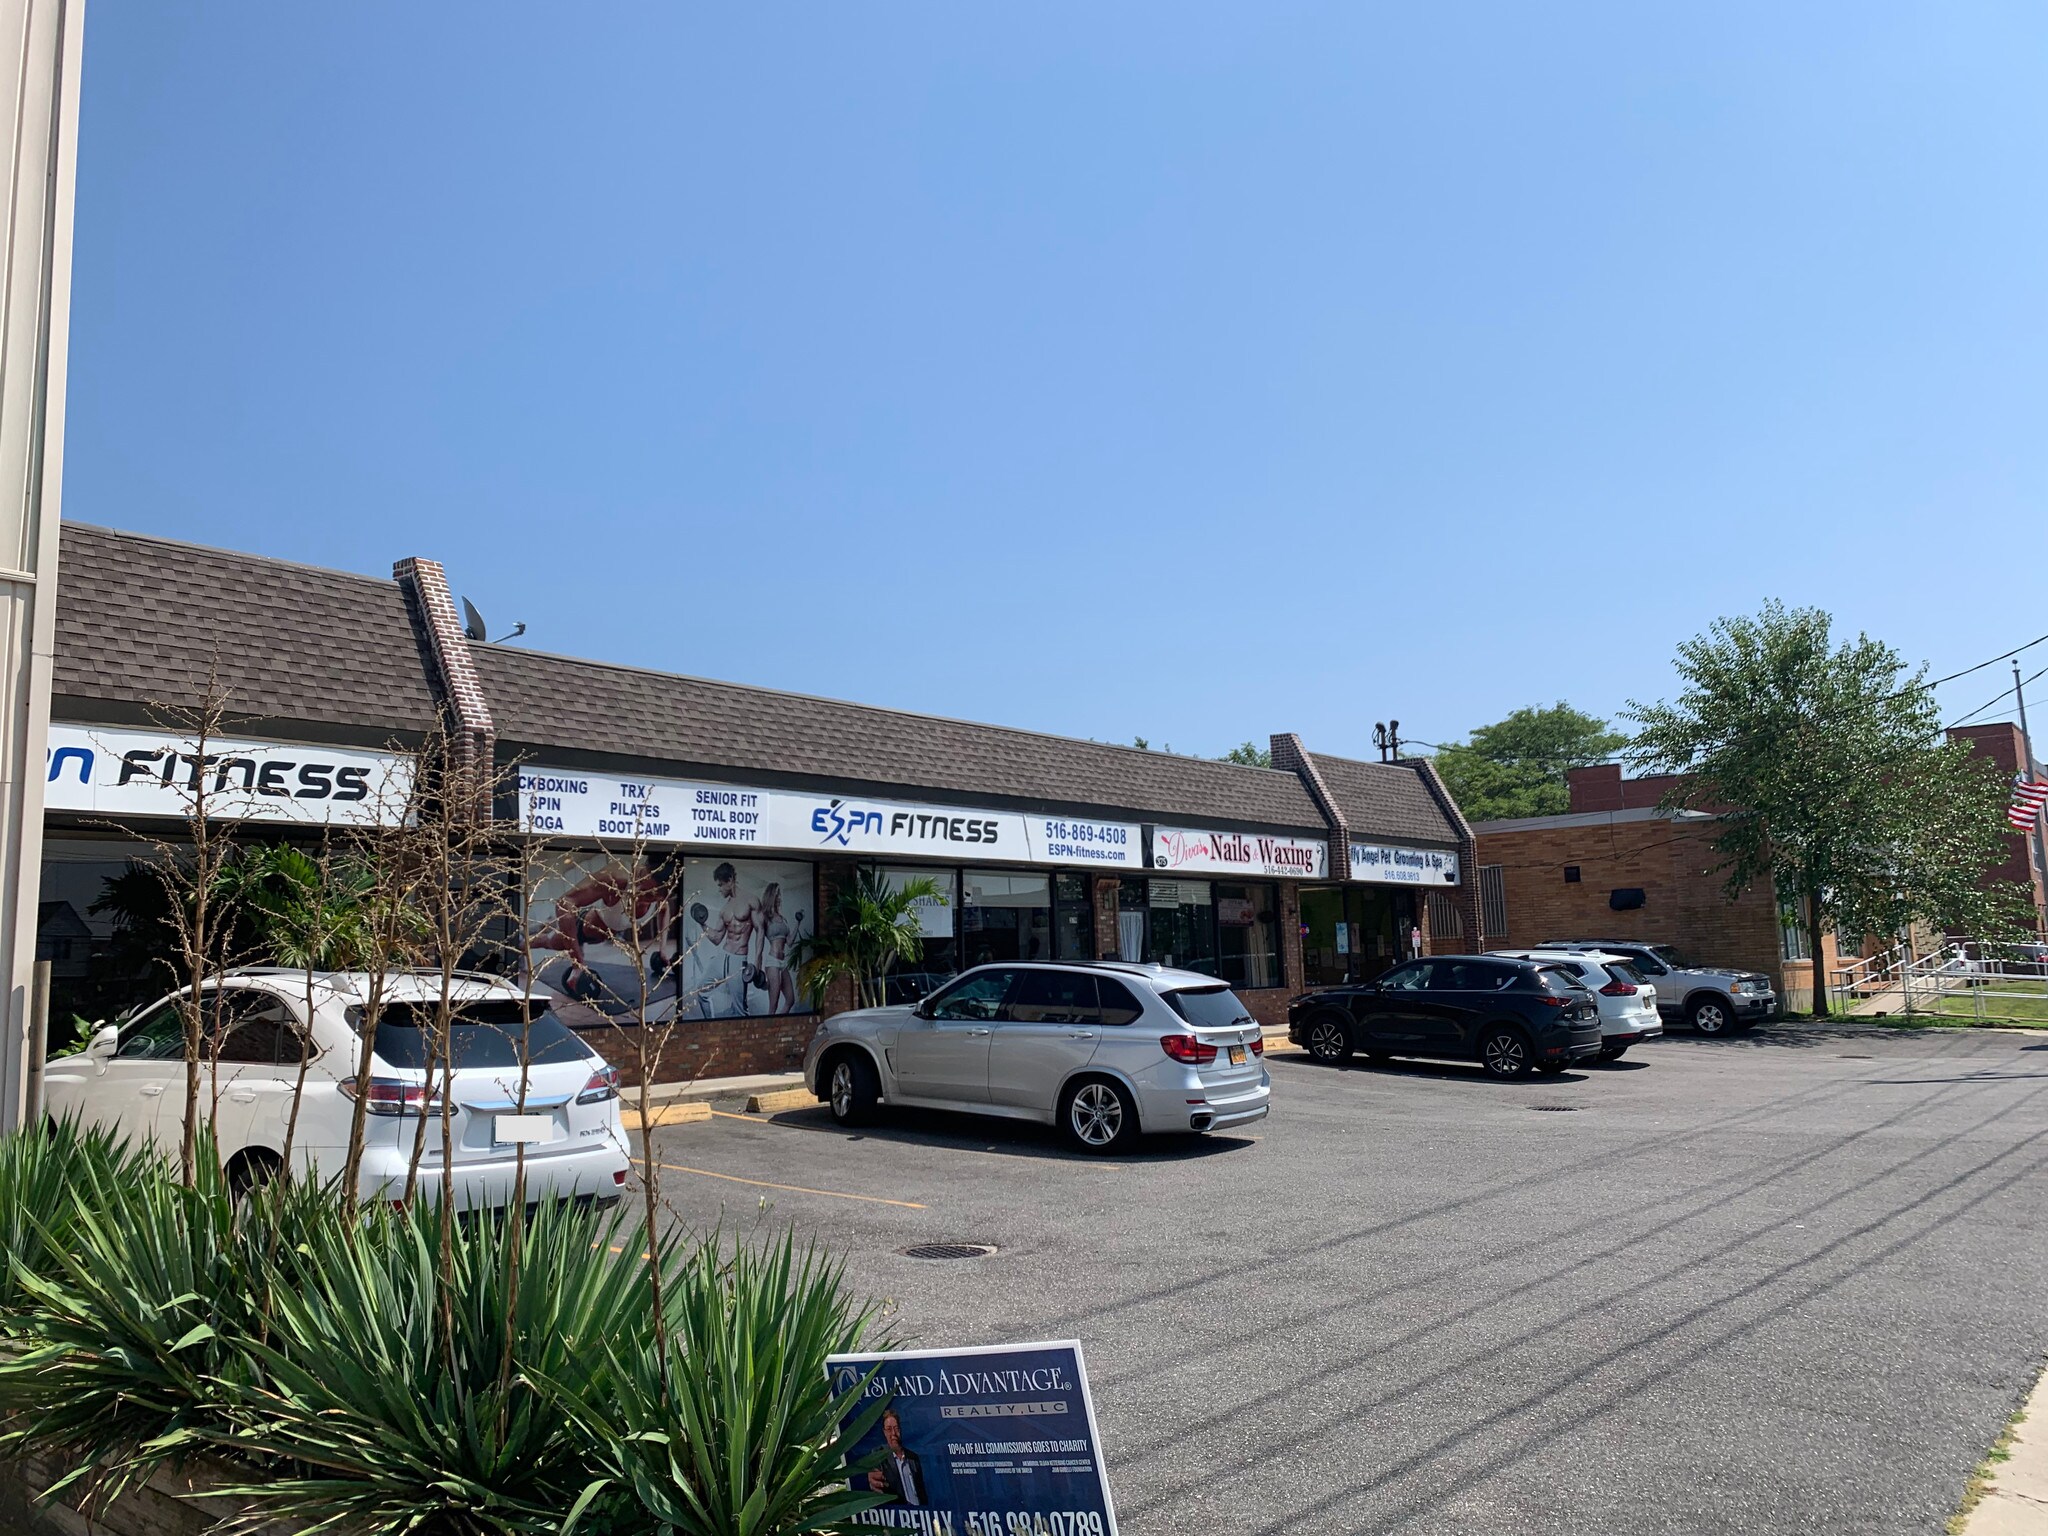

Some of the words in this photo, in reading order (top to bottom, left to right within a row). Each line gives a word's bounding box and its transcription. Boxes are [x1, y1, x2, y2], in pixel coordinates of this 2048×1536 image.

[118, 748, 371, 800] FITNESS
[620, 783, 646, 799] TRX
[696, 790, 738, 806] SENIOR
[741, 793, 758, 808] FIT
[529, 796, 561, 811] SPIN
[610, 801, 660, 818] PILATES
[526, 814, 563, 830] YOGA
[691, 808, 726, 823] TOTAL
[730, 811, 759, 825] BODY
[811, 802, 883, 845] ESPN
[891, 812, 999, 844] FITNESS
[599, 819, 633, 834] BOOT
[637, 821, 670, 836] CAMP
[694, 826, 736, 840] JUNIOR
[739, 828, 757, 842] FIT
[1046, 821, 1127, 845] 516-869-4508
[1048, 843, 1126, 861] ESPN-fitness.com
[1209, 833, 1251, 864] Nails
[1256, 838, 1313, 873] Waxing
[1361, 847, 1379, 867] Angel
[1381, 849, 1391, 865] Pet
[1394, 849, 1424, 869] Grooming
[1425, 852, 1431, 867] &
[1432, 853, 1442, 871] Spa
[966, 1442, 973, 1454] OF
[974, 1442, 986, 1454] ALL
[986, 1441, 1032, 1453] COMMISSIONS
[1032, 1440, 1049, 1453] GOES
[1049, 1440, 1058, 1452] TO
[1058, 1439, 1087, 1452] CHARITY
